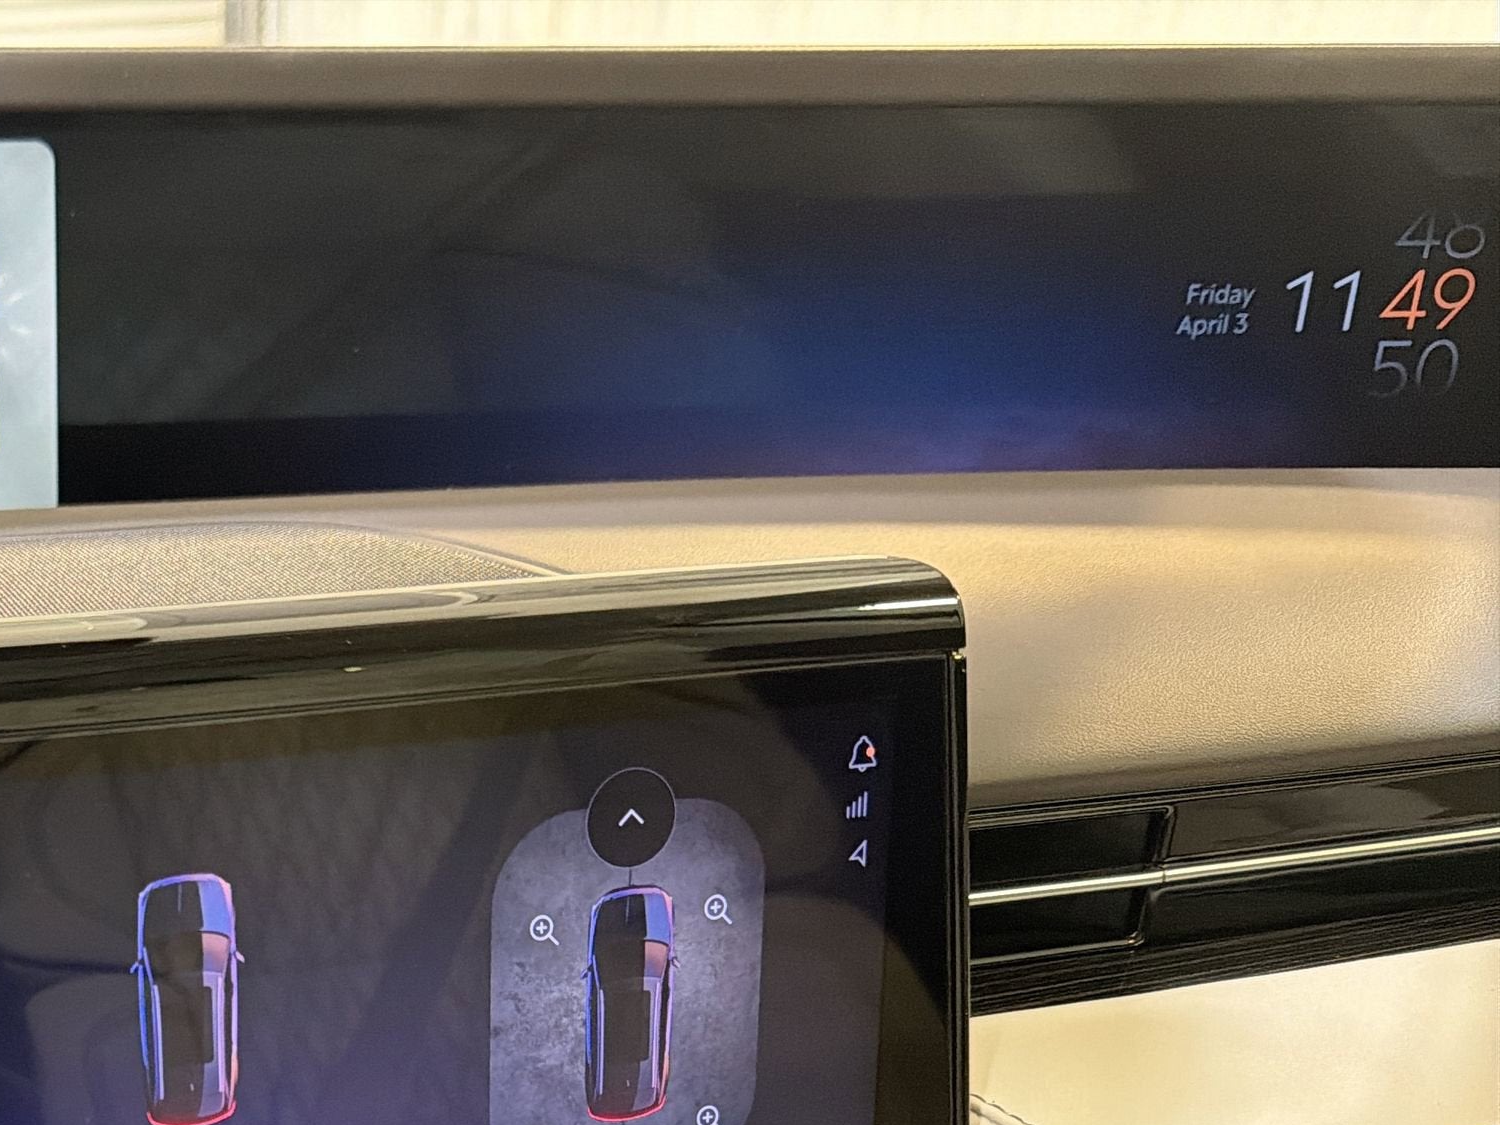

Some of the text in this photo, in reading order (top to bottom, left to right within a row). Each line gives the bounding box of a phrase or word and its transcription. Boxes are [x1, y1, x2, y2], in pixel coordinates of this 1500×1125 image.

[1184, 283, 1257, 310] Friday
[1285, 267, 1477, 333] 11 49
[1175, 312, 1250, 341] April 3
[1368, 338, 1460, 400] 50
